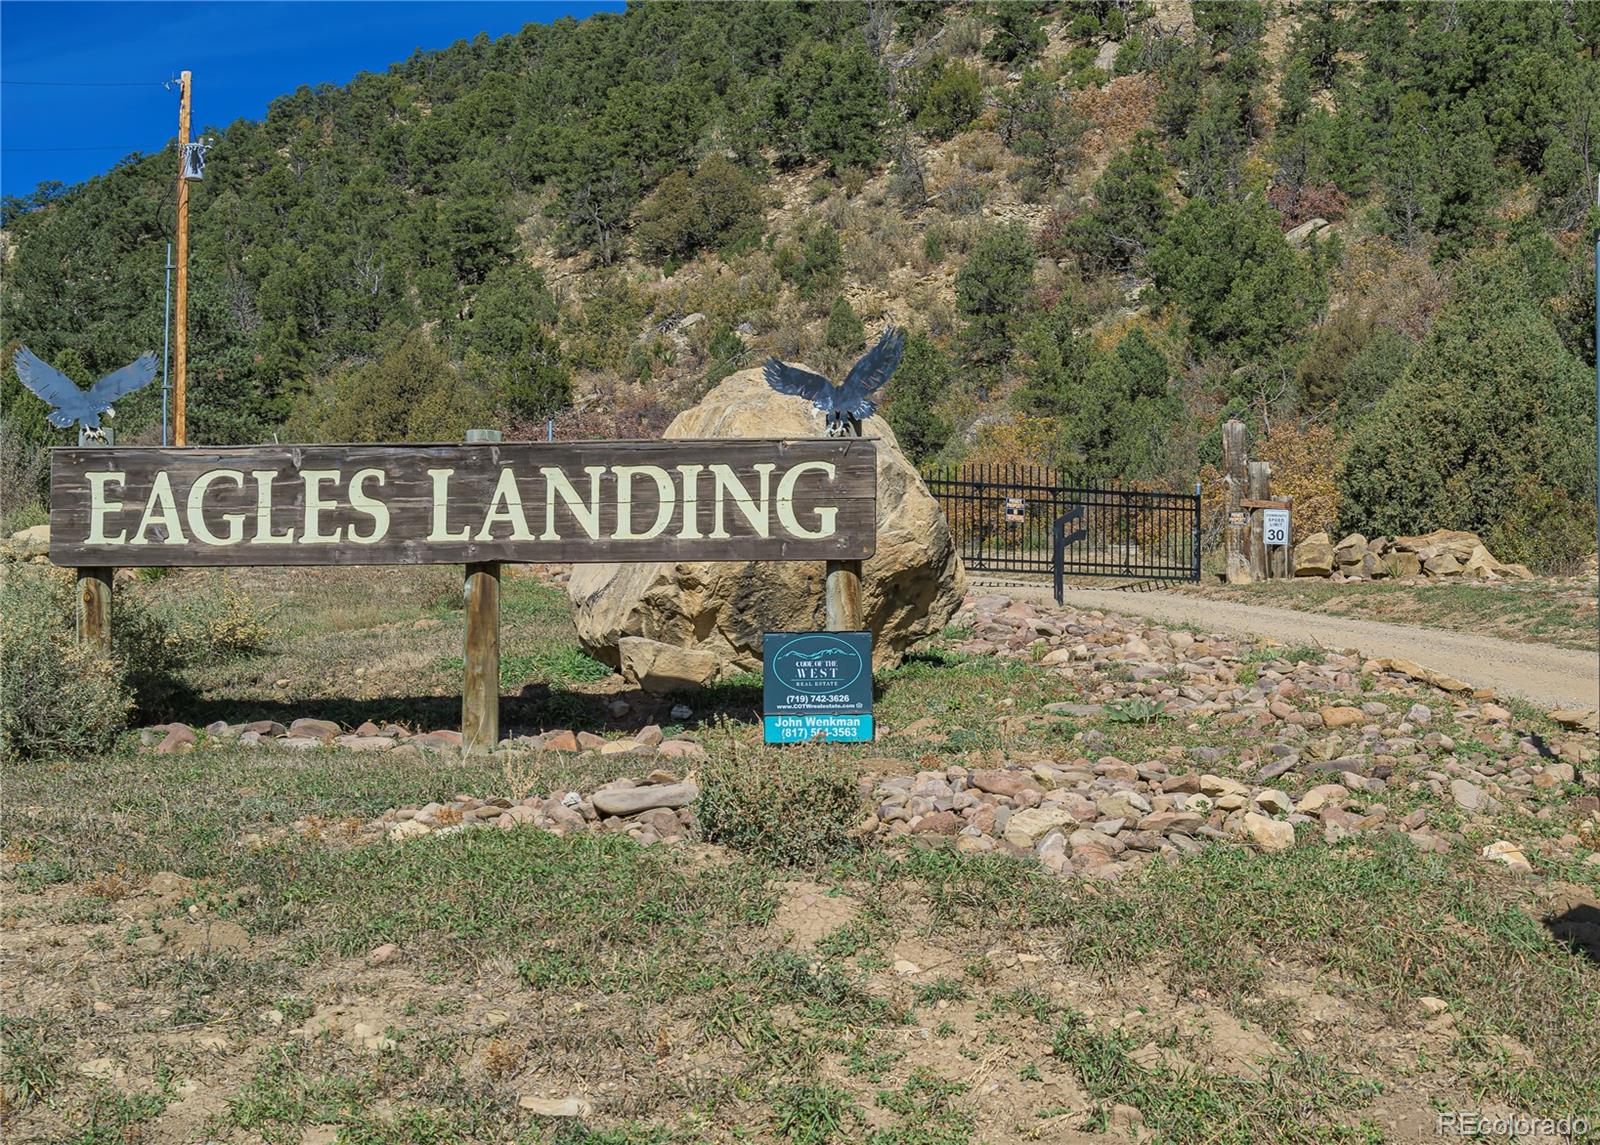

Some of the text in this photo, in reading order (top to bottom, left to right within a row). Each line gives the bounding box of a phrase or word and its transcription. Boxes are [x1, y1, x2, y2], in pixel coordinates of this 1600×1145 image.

[84, 460, 840, 547] EAGLES LANDING
[1267, 529, 1285, 541] 30
[796, 668, 839, 678] WEST
[786, 695, 850, 704] (719) 742-3626
[774, 716, 861, 727] John Wenkman
[781, 728, 808, 738] (817)
